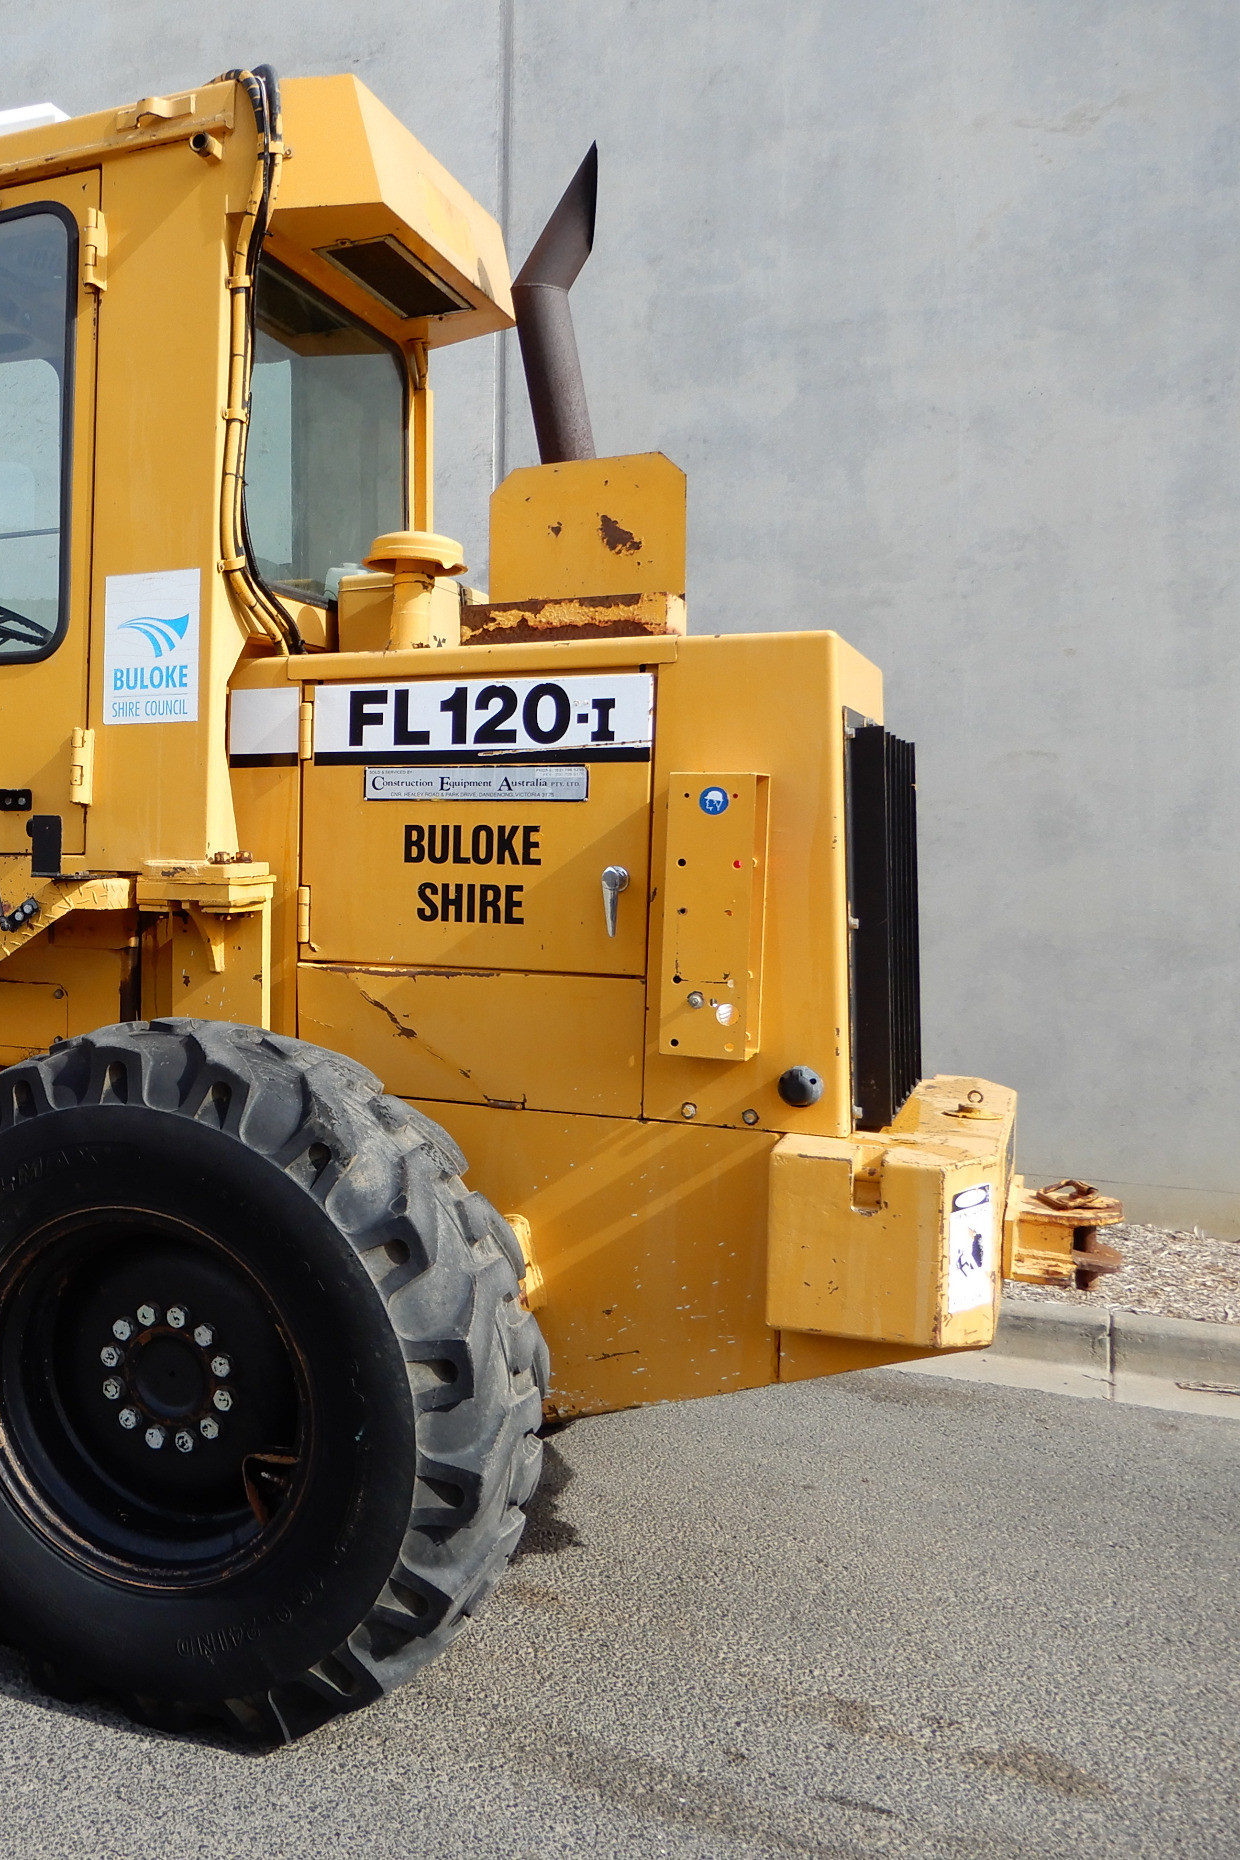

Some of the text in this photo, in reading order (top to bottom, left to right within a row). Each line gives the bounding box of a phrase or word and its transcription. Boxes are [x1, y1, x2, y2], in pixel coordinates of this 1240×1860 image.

[113, 665, 188, 691] BULOKE
[112, 699, 188, 718] SHIRE COUNCIL
[371, 776, 433, 791] Construction
[438, 776, 492, 792] Equipment
[497, 776, 548, 792] Australia
[403, 825, 542, 866] BULOKE
[417, 882, 524, 925] SHIRE
